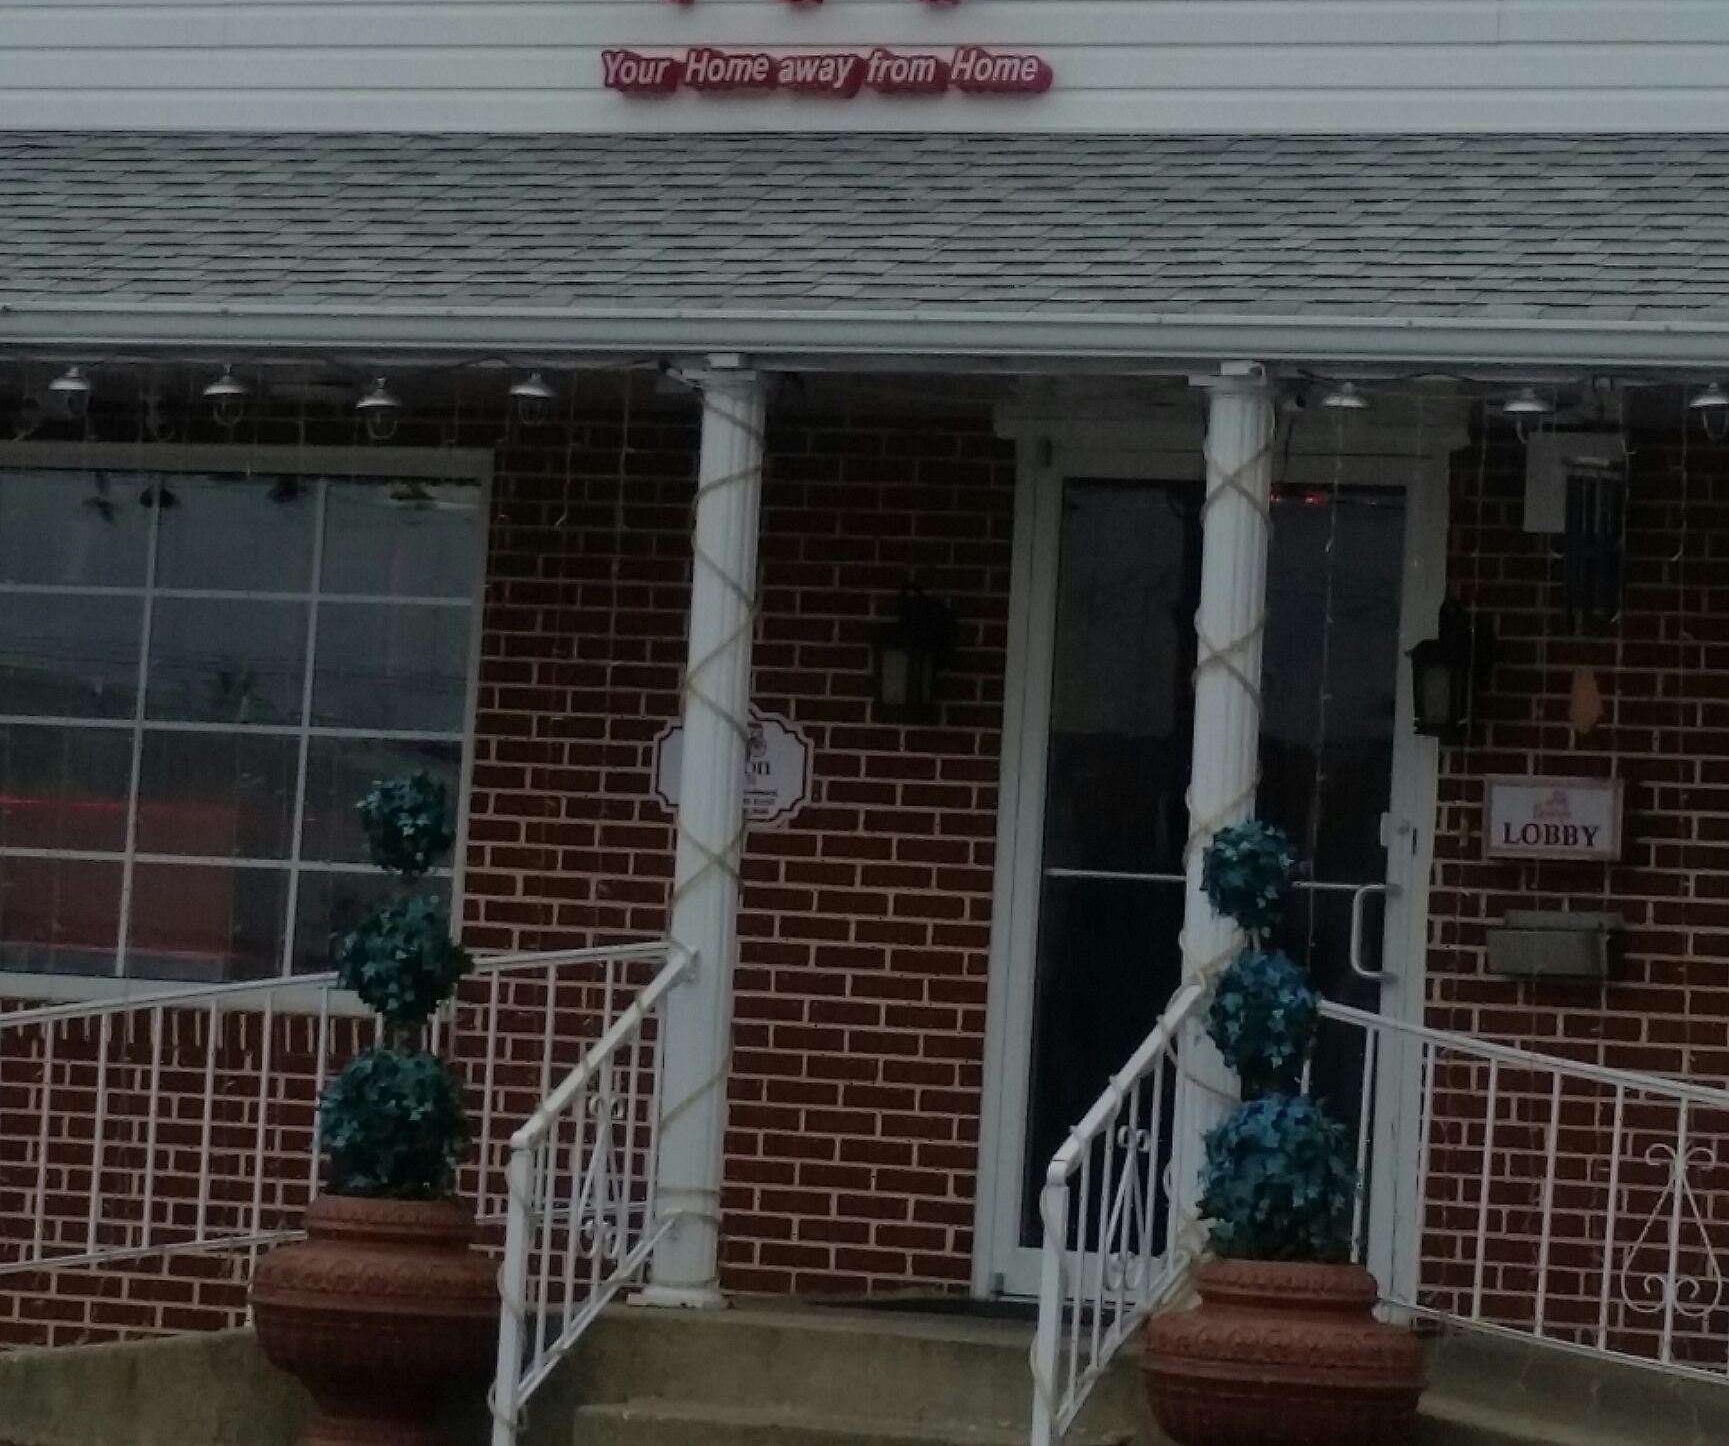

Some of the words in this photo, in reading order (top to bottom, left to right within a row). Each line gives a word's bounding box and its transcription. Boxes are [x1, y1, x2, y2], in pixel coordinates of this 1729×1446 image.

[602, 51, 674, 90] Your
[684, 48, 772, 87] Home
[778, 53, 858, 96] away
[866, 49, 940, 90] from
[951, 47, 1047, 90] Home
[1503, 822, 1599, 847] LOBBY
